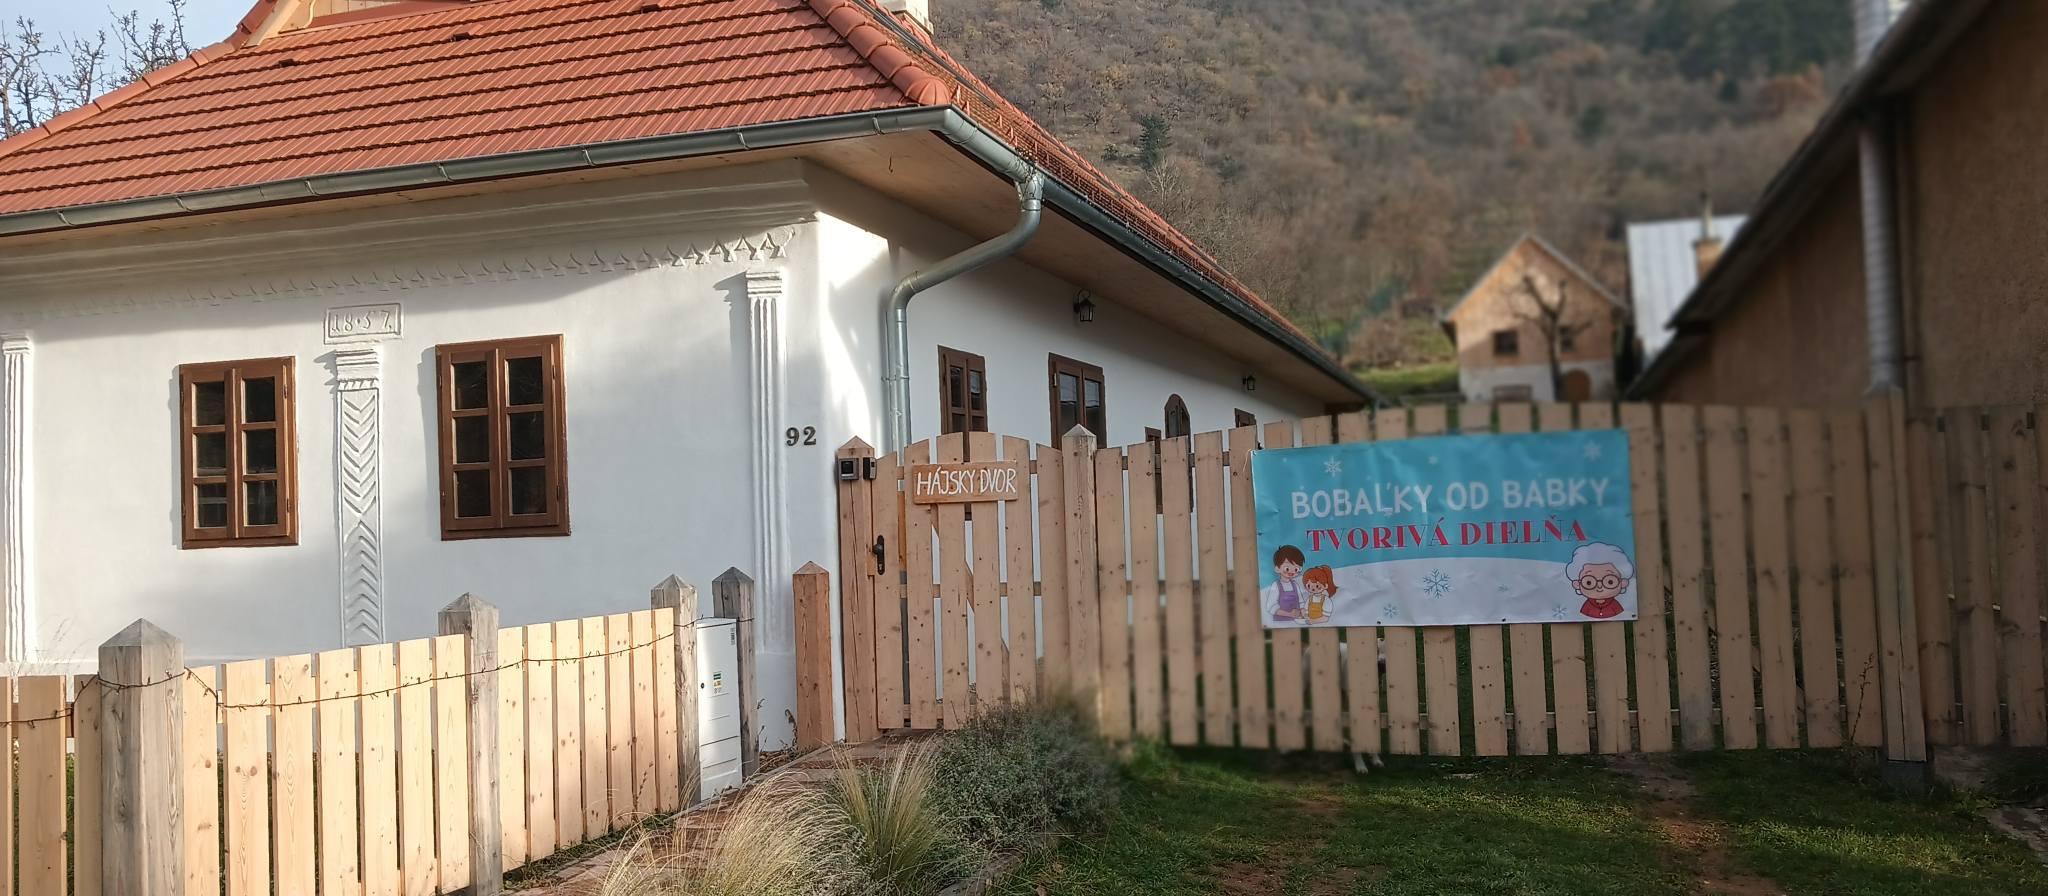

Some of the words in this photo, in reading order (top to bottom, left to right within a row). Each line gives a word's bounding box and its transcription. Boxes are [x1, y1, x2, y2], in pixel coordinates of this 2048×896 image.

[785, 426, 817, 446] 92
[916, 466, 976, 495] HÁJSKY
[978, 468, 1017, 494] DVOR
[1291, 481, 1433, 519] BOBAĽKY
[1446, 481, 1490, 512] OD
[1502, 476, 1611, 510] BABKY
[1306, 517, 1450, 552] TVORIVÁ
[1460, 514, 1587, 546] DIELŇA
